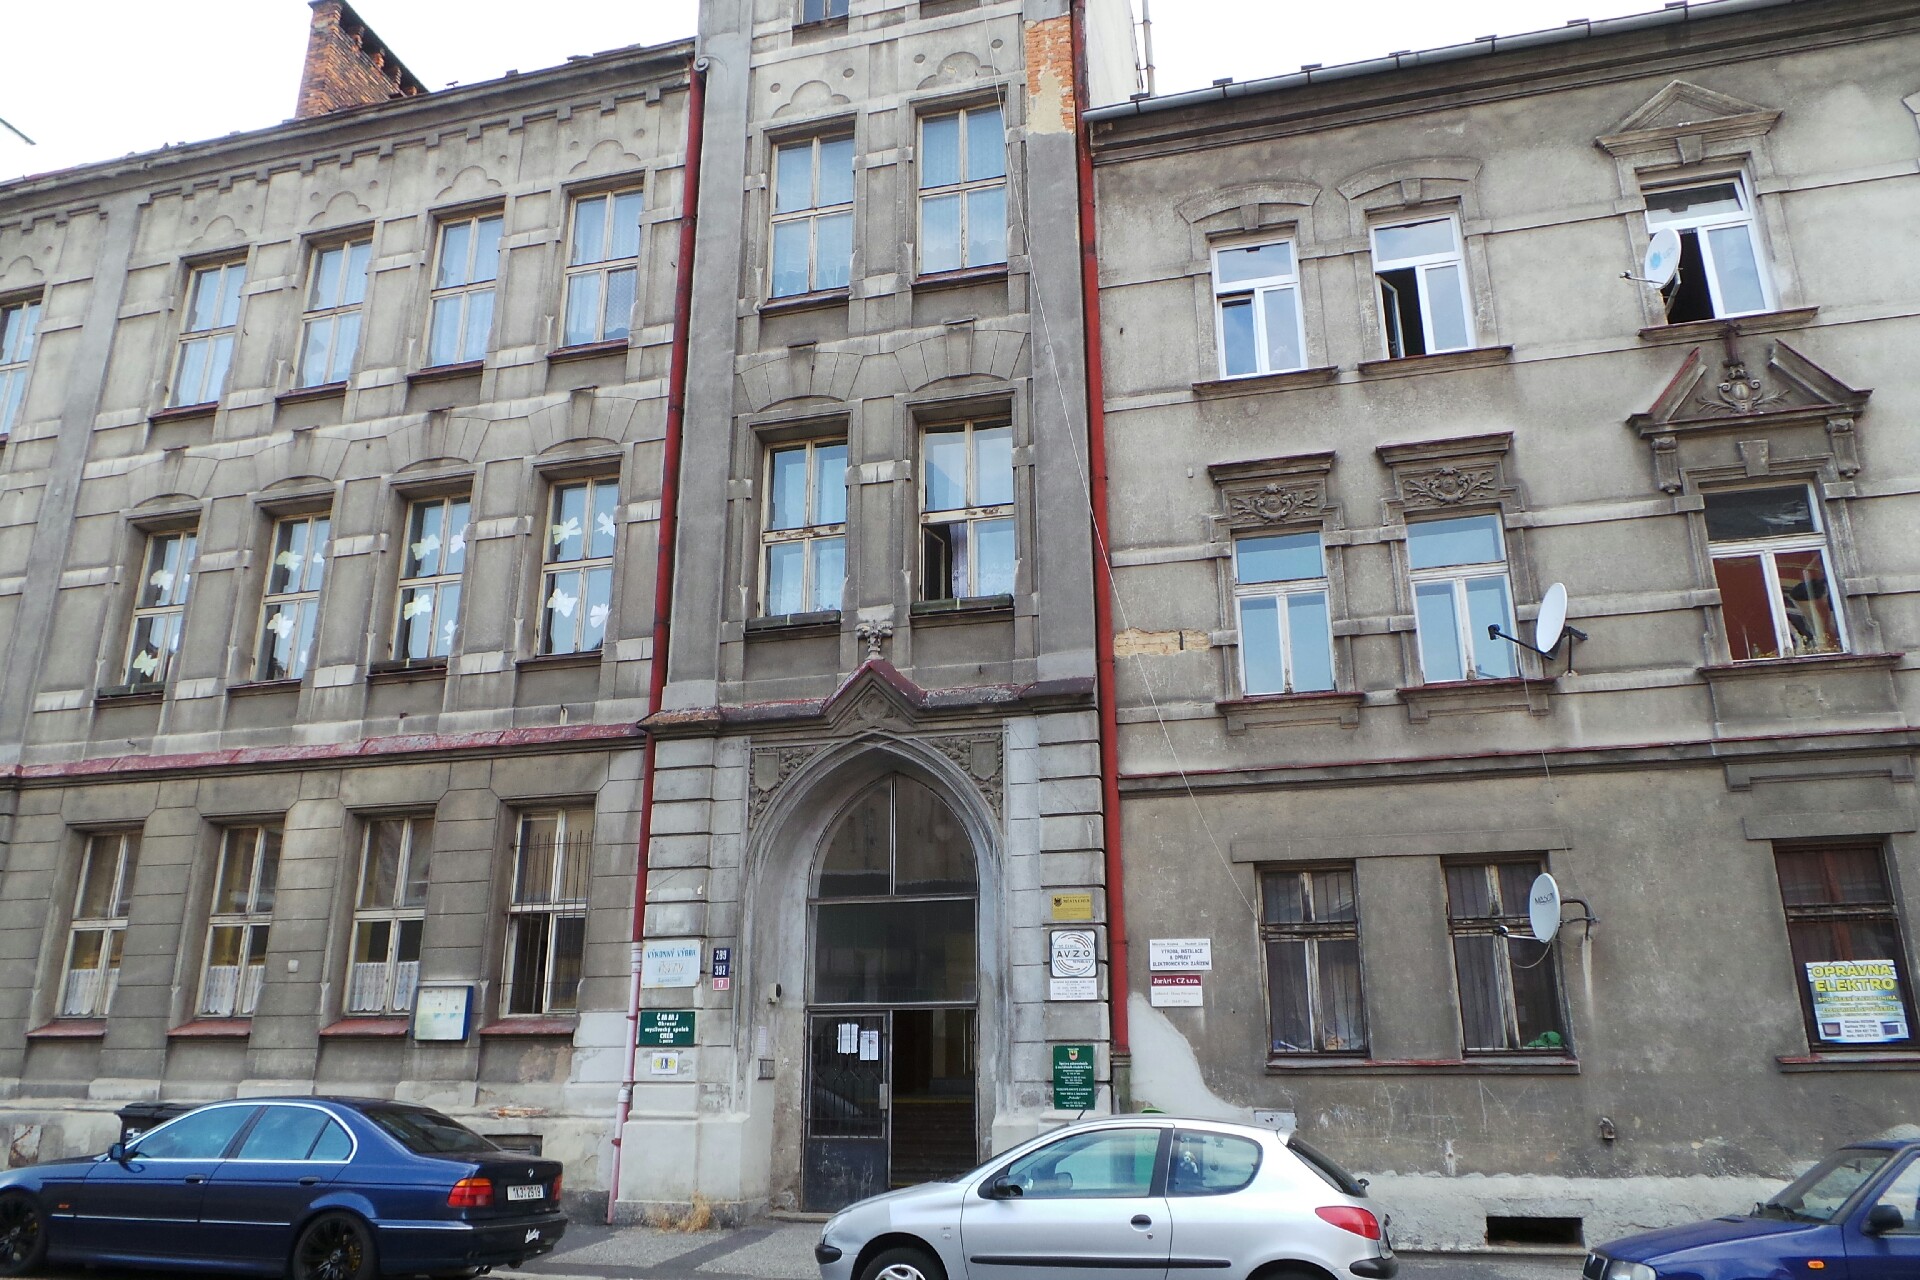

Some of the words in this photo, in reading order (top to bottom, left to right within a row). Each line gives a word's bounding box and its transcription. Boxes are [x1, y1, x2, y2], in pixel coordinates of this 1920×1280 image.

[1057, 950, 1091, 959] AVZO
[1812, 965, 1893, 977] OPRAVNA
[718, 980, 724, 988] 17
[1814, 978, 1895, 992] ELEKTRO
